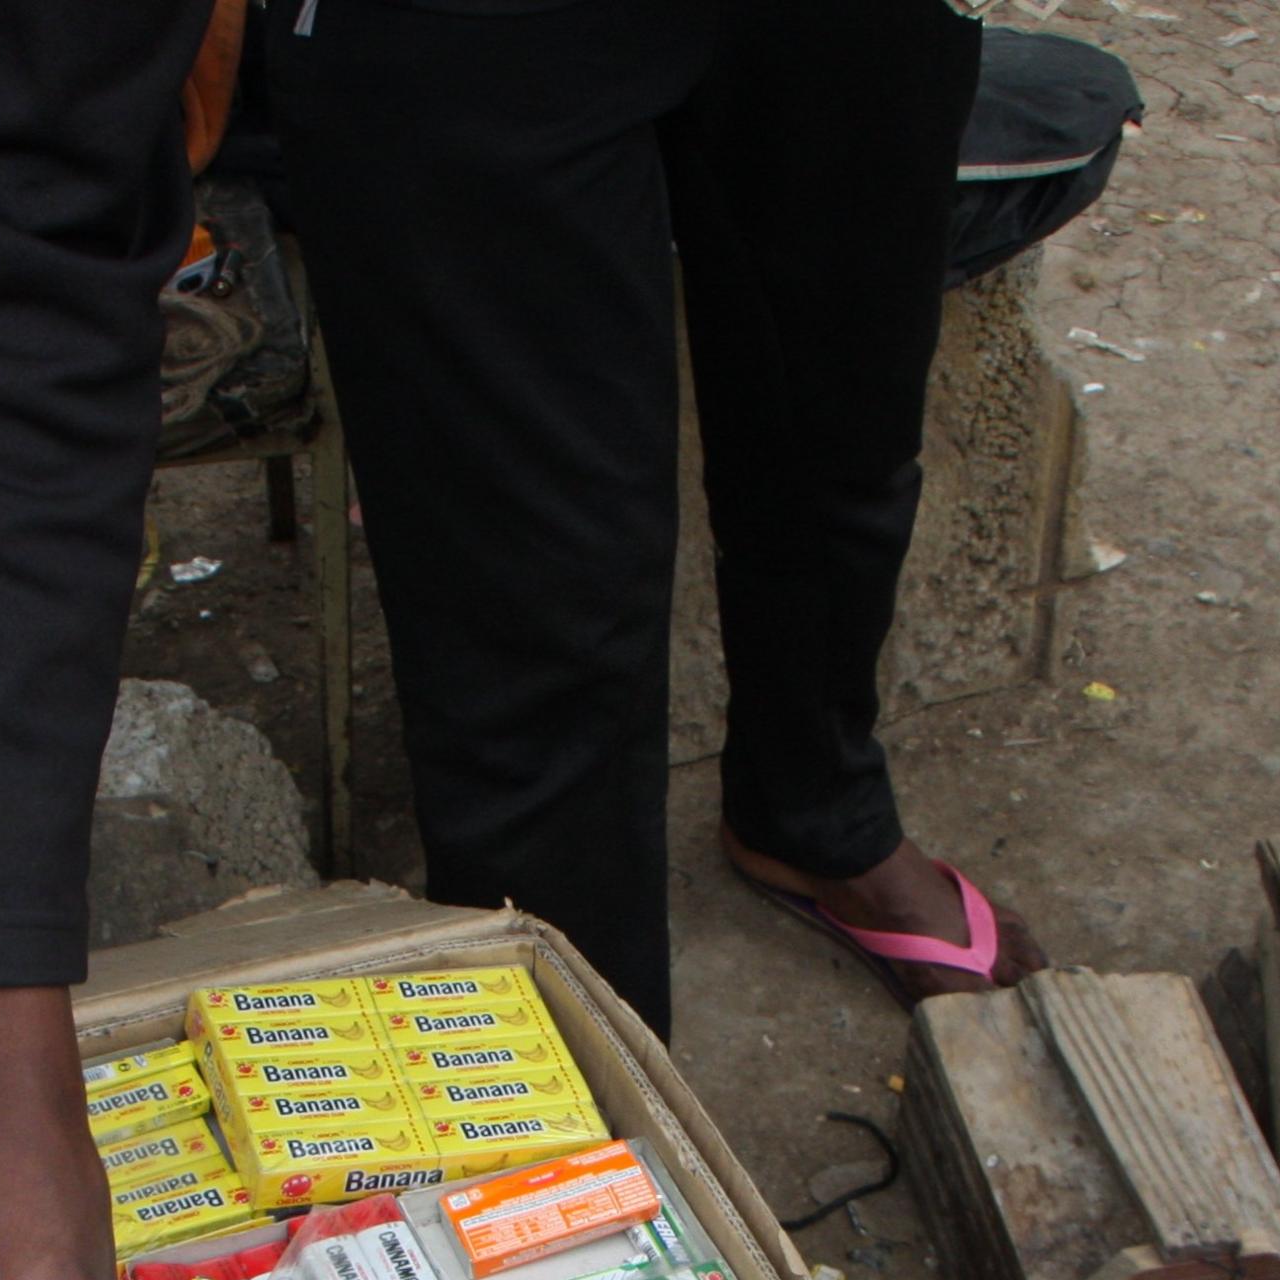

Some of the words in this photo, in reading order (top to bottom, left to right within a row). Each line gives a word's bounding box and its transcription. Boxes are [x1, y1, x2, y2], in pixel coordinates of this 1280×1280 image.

[398, 980, 478, 999] Banana
[234, 992, 315, 1011] Banana
[415, 1013, 495, 1033] Banana
[246, 1026, 329, 1044] Banana
[432, 1049, 513, 1069] Banana
[263, 1064, 347, 1082] Banana
[446, 1082, 529, 1102] Banana
[275, 1097, 360, 1116] Banana
[460, 1119, 543, 1140] Banana
[287, 1137, 373, 1158] Banana
[345, 1168, 444, 1193] Banana
[136, 1188, 225, 1222] Banana
